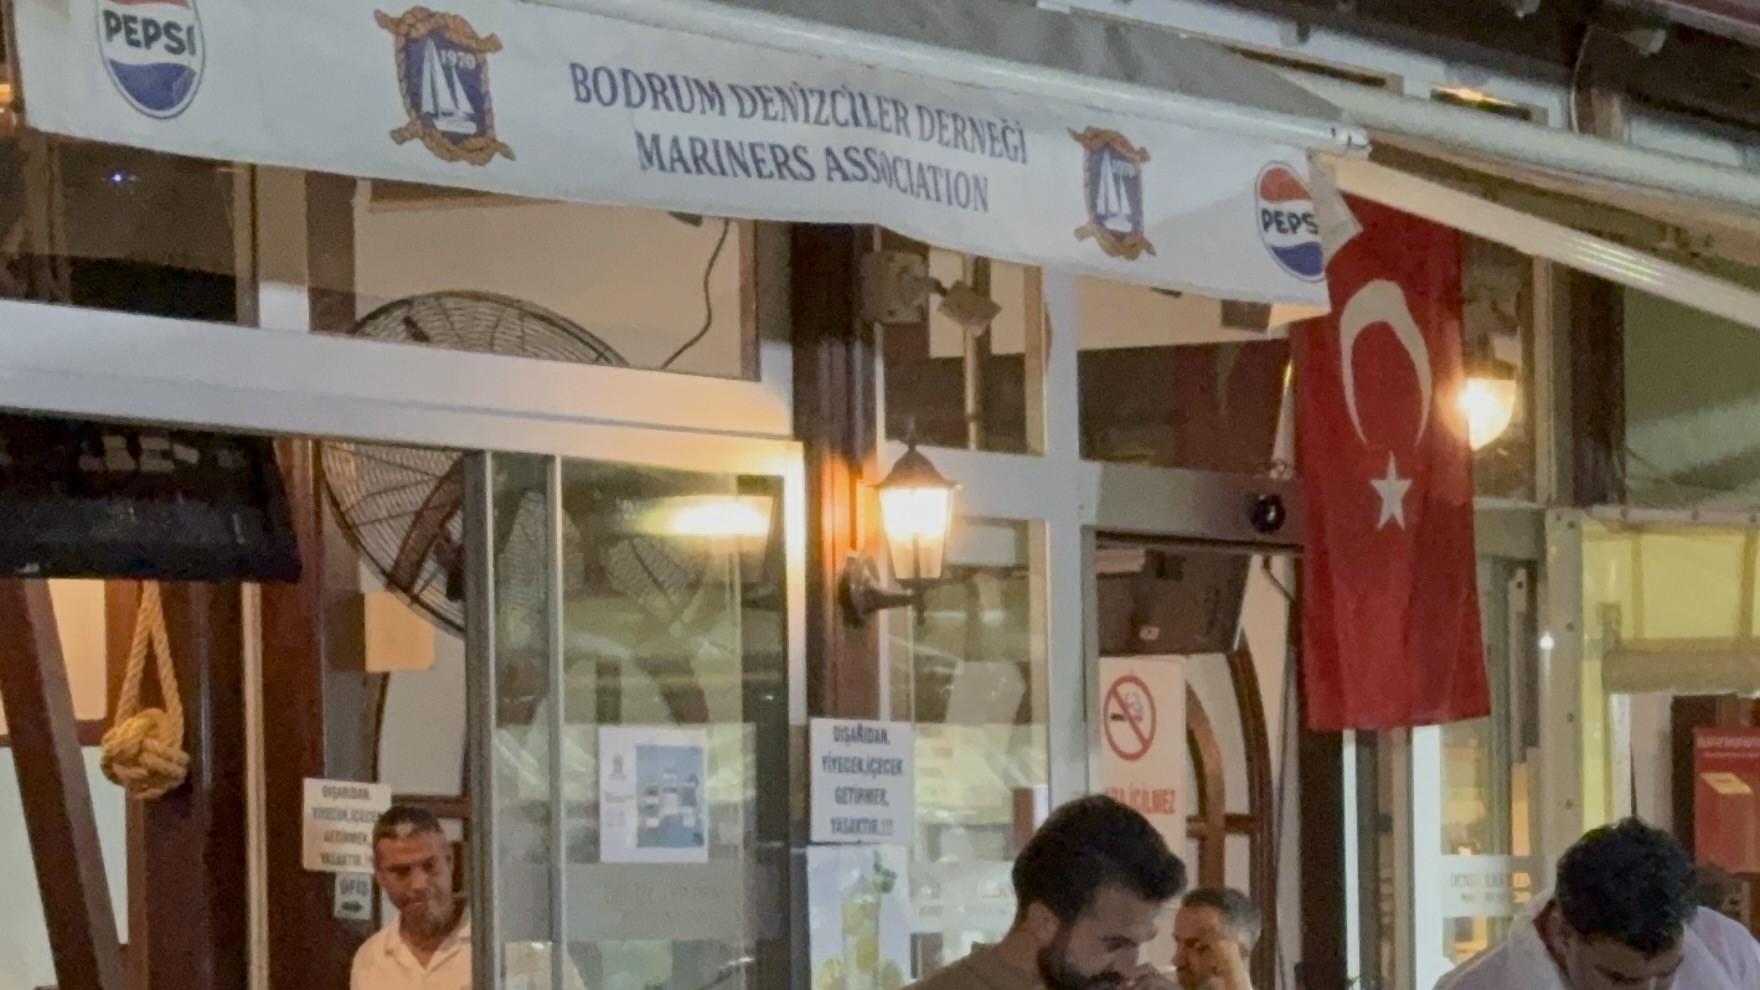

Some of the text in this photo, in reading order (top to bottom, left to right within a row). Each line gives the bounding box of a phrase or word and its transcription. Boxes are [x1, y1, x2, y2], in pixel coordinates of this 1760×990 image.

[102, 9, 197, 56] PEPSI
[569, 62, 727, 117] BODRUM
[914, 104, 1028, 165] DERNEĞİ
[633, 128, 990, 213] MARINERS ASSOCIATION
[1261, 207, 1319, 235] PEPS
